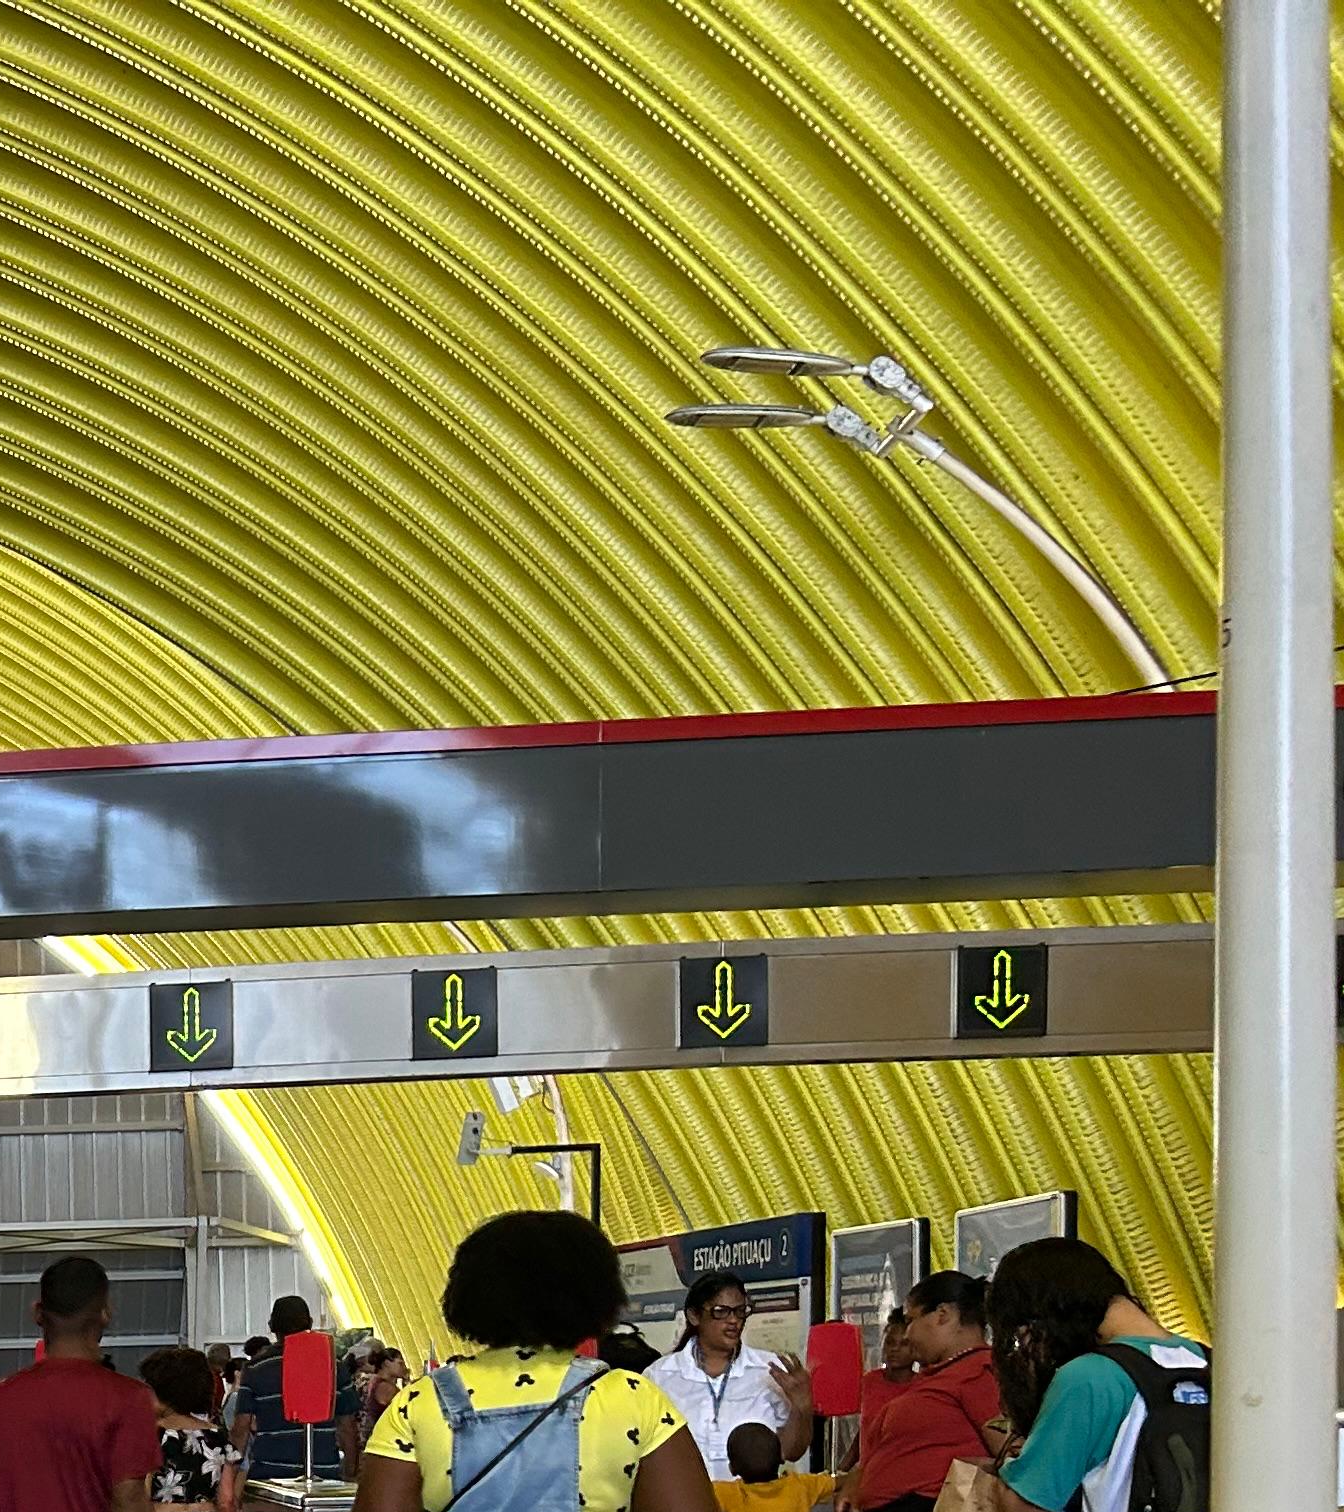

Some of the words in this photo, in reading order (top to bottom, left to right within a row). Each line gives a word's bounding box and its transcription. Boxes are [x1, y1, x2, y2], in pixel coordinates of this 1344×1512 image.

[693, 1239, 732, 1272] ESTAÇÃO
[732, 1237, 772, 1269] PITUAÇU
[782, 1234, 788, 1256] 2
